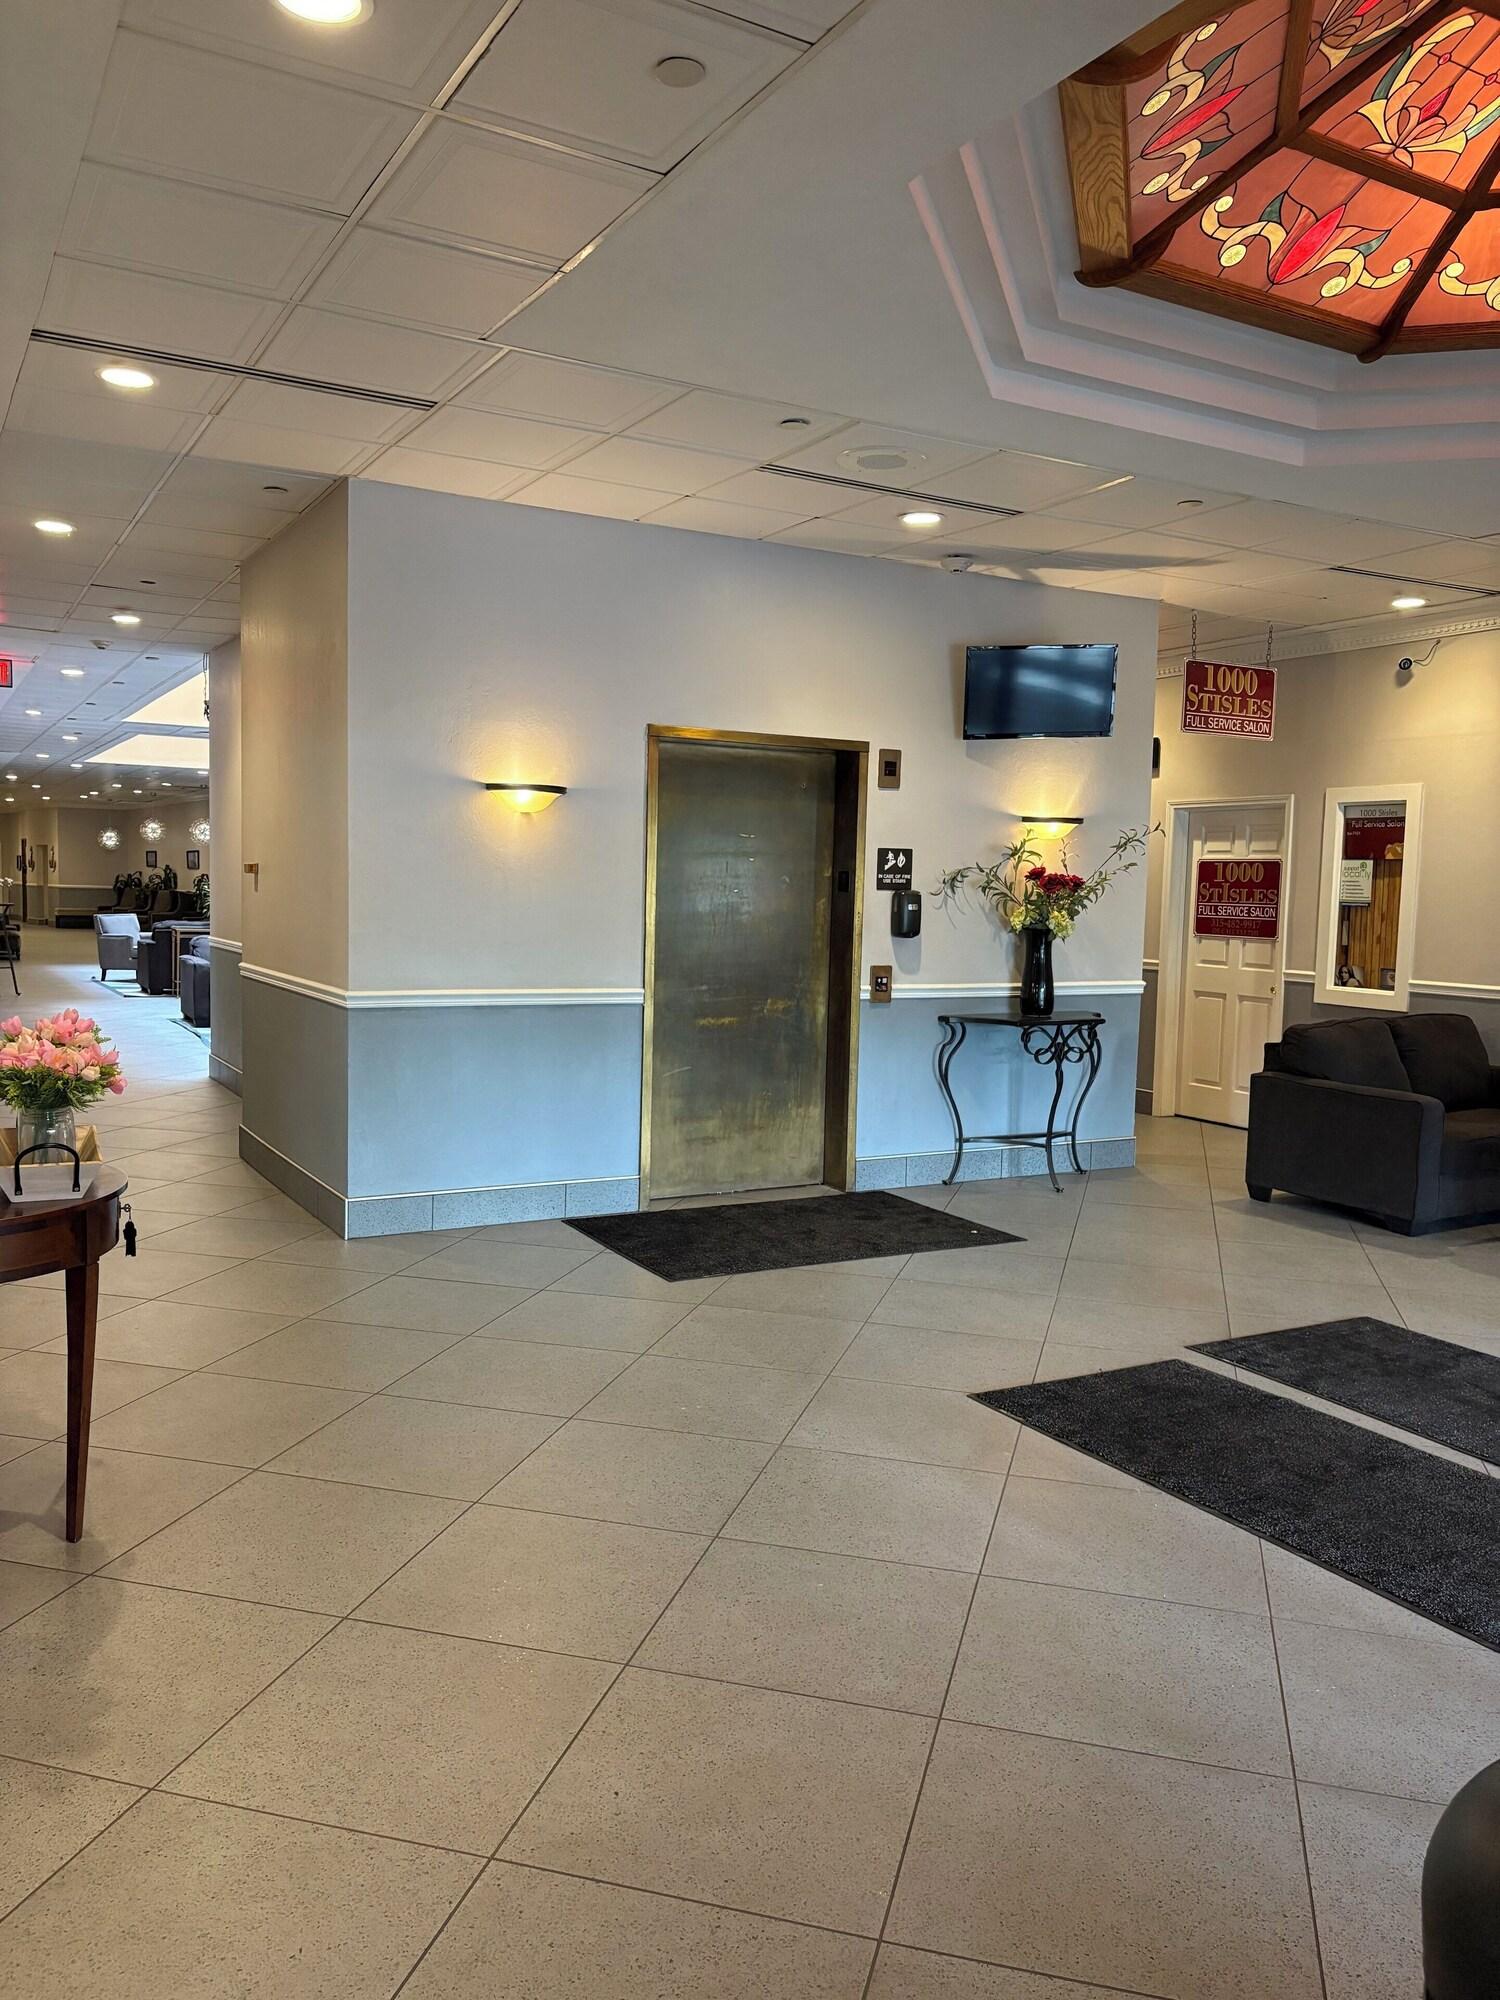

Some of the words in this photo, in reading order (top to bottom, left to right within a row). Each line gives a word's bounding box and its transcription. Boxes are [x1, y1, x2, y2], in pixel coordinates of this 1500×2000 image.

[1204, 664, 1258, 696] 1000
[1186, 683, 1272, 719] STISLES
[1186, 715, 1206, 728] FULL
[1208, 717, 1242, 731] SERVICE
[1243, 720, 1270, 734] SALON
[1360, 808, 1377, 817] 1000
[1351, 820, 1363, 828] Full
[1213, 862, 1265, 883] 1000
[1198, 905, 1216, 915] FULL
[1217, 906, 1249, 917] SERVICE
[1250, 906, 1276, 918] SALON
